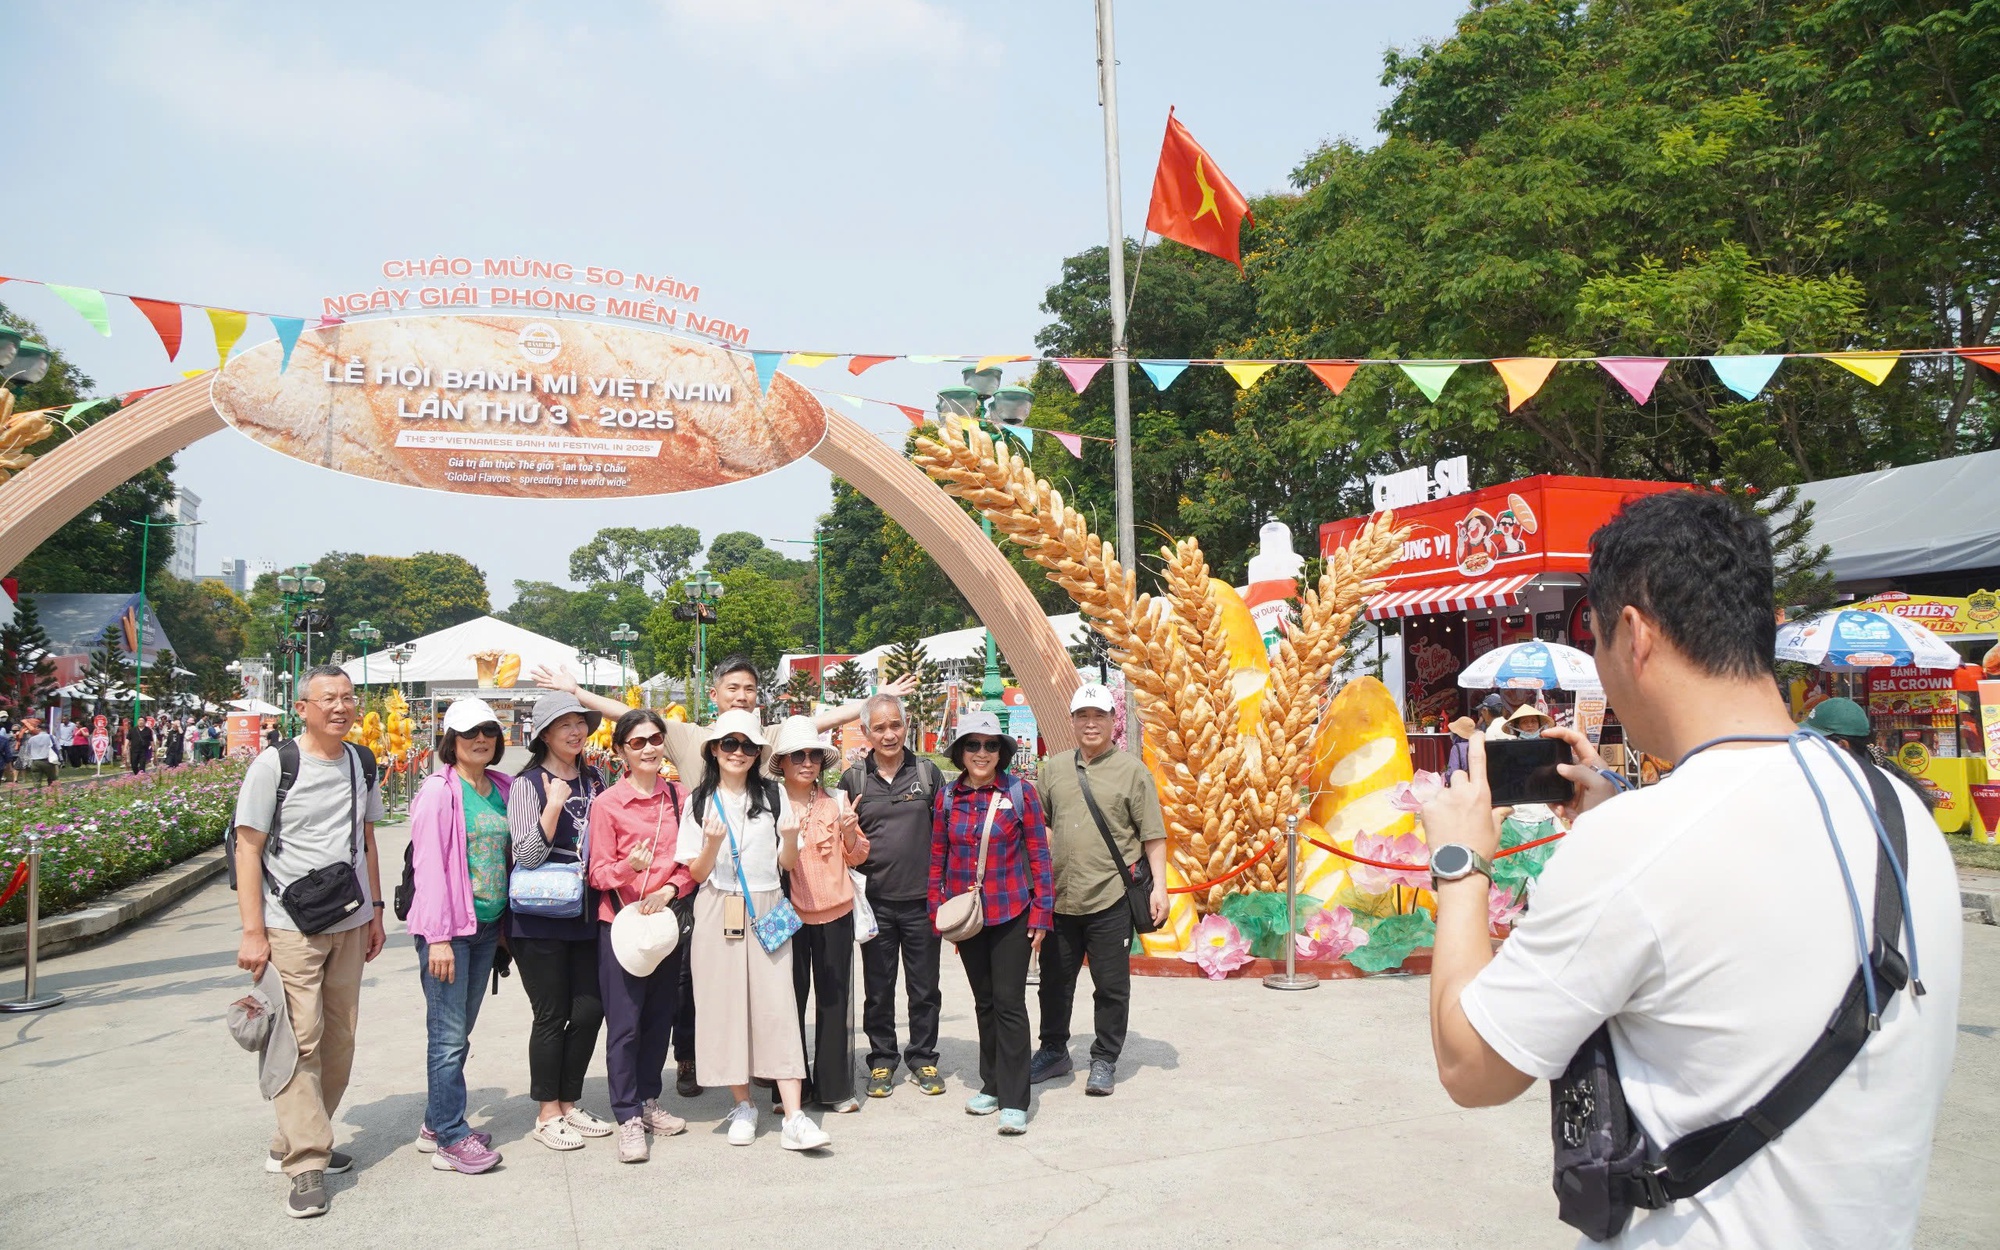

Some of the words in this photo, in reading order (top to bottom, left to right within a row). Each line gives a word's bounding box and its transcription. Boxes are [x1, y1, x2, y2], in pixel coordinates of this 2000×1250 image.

[382, 255, 473, 279] CHÀO
[483, 256, 574, 281] MỪNG
[586, 266, 625, 287] 50
[634, 273, 700, 303] NĂM
[322, 287, 411, 315] NGÀY
[419, 283, 478, 306] GIẢI
[490, 286, 597, 312] PHÓNG
[606, 298, 678, 326] MIỀN
[685, 312, 751, 345] NAM
[376, 364, 431, 391] HỘI
[543, 371, 578, 395] MÌ
[587, 373, 655, 401] VIỆT
[664, 380, 732, 402] NAM
[549, 405, 569, 425] 3
[599, 407, 675, 429] 2025
[405, 435, 426, 443] THE
[446, 437, 513, 447] VIETNAMESE
[516, 438, 545, 448] BANH
[562, 442, 609, 450] FESTIVAL
[448, 457, 464, 467] Giá
[466, 457, 476, 469] trị
[495, 458, 516, 470] thực
[563, 462, 577, 471] lan
[595, 463, 602, 472] 5
[603, 462, 627, 473] Châu
[478, 472, 511, 483] Flavors
[519, 473, 562, 486] spreading
[565, 476, 579, 485] the
[581, 477, 606, 486] world
[1433, 534, 1451, 560] VỊ
[1872, 679, 1896, 691] SEA
[1899, 677, 1953, 690] CROWN
